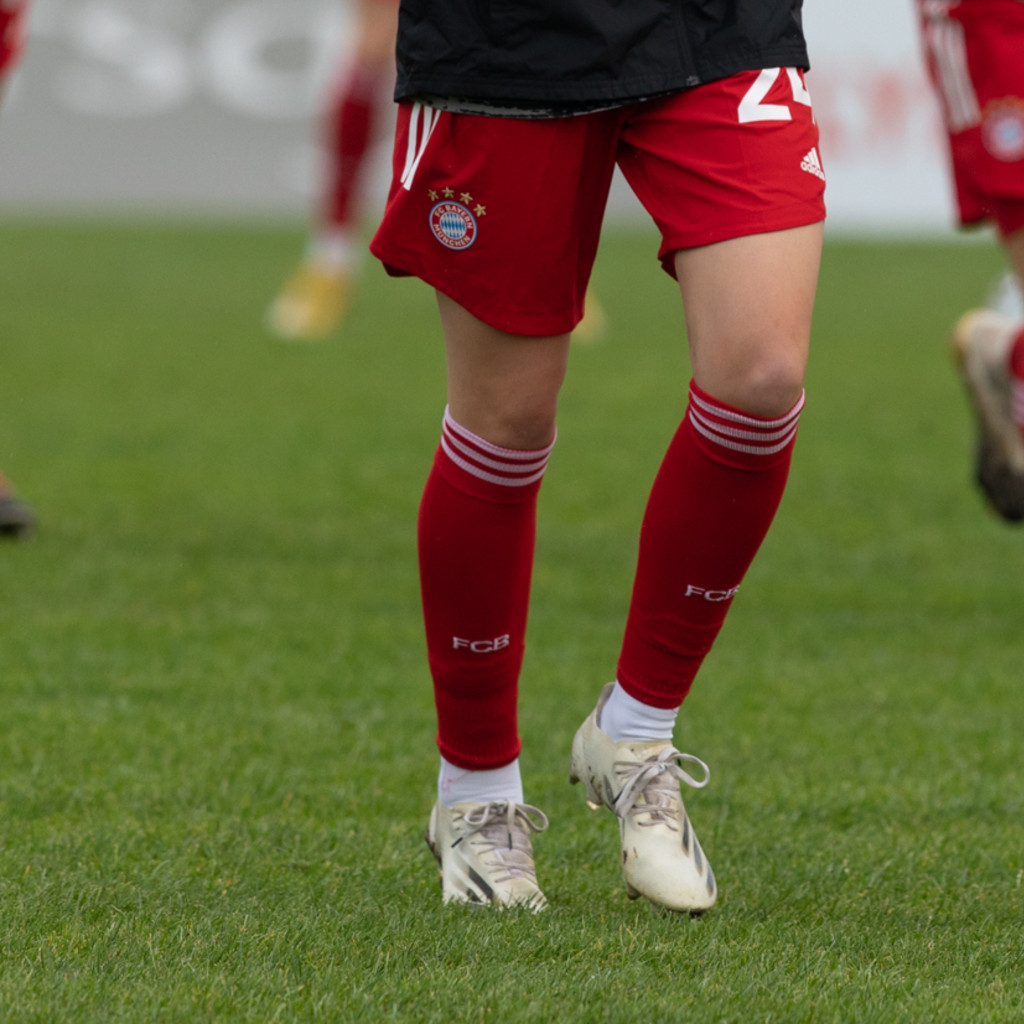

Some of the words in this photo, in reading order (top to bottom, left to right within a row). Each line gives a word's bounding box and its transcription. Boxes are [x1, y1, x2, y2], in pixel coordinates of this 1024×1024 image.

[434, 207, 445, 218] FC
[445, 204, 473, 229] BAYERN
[453, 633, 510, 653] FCB
